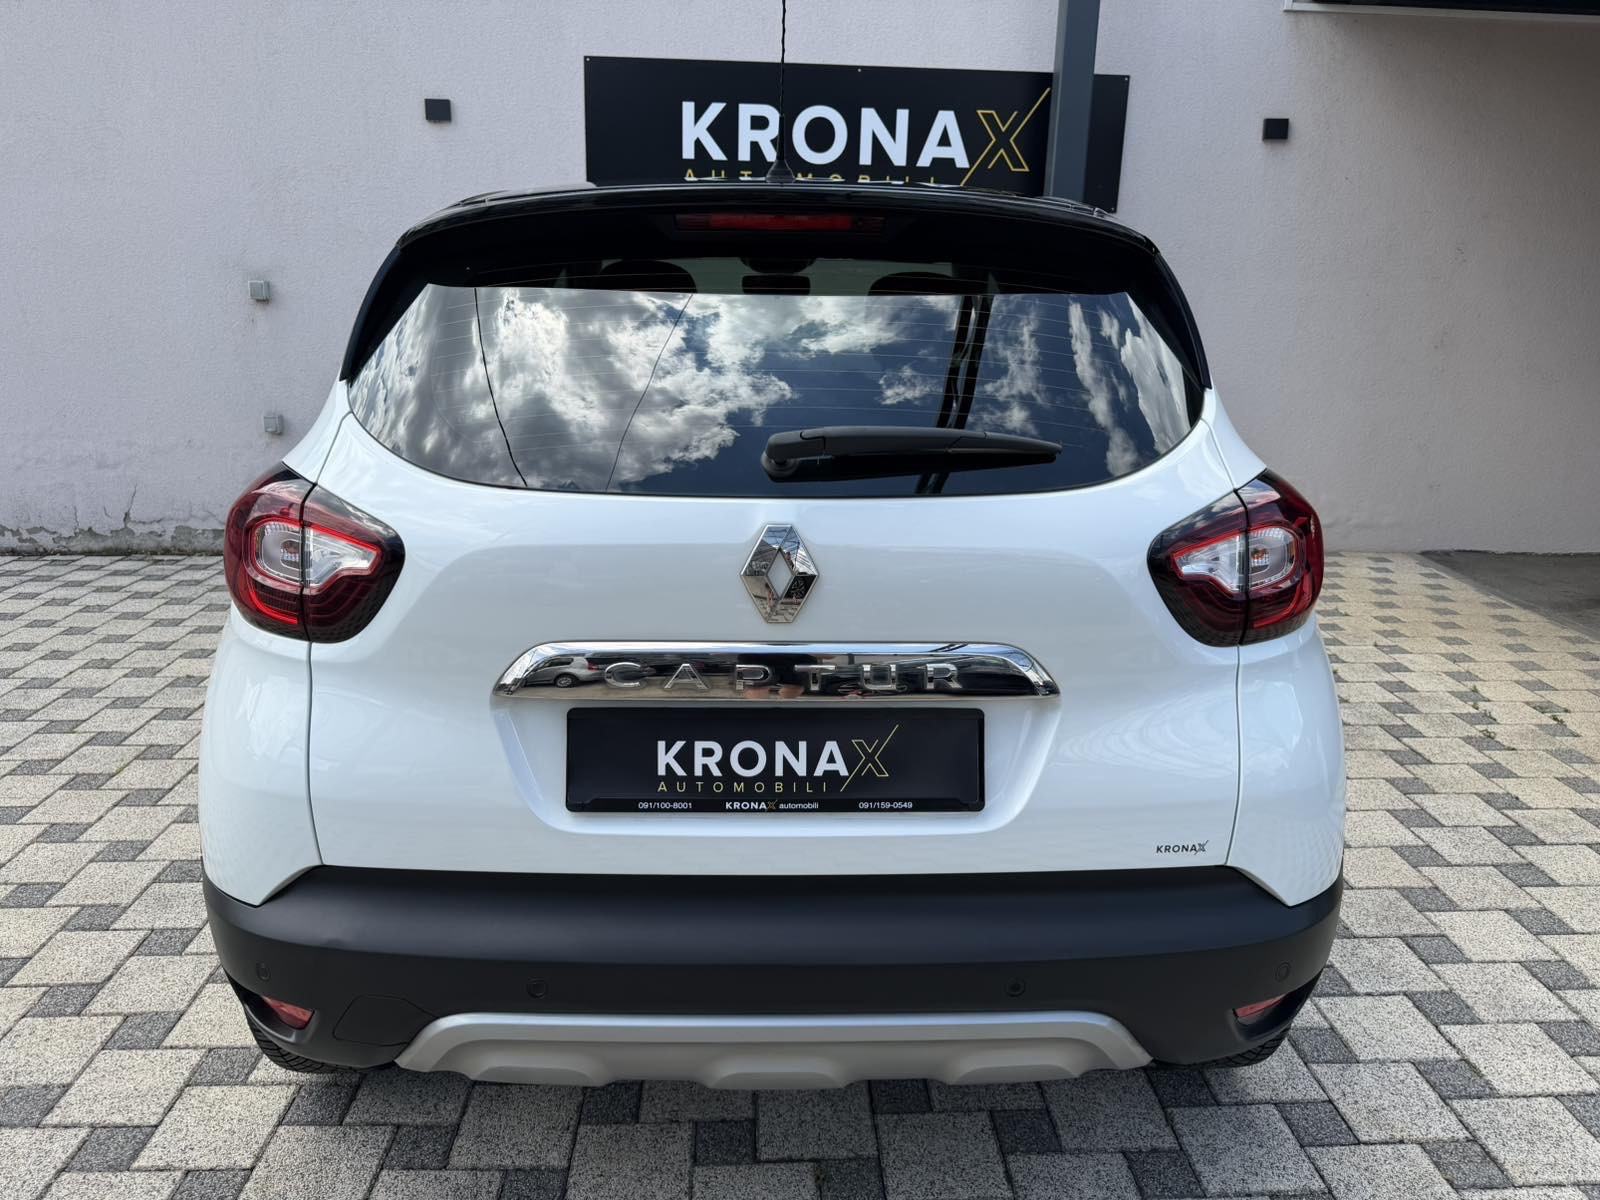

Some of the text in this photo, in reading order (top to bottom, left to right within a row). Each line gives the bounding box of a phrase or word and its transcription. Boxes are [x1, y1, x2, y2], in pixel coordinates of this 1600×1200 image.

[681, 87, 1051, 187] KRONAX
[604, 661, 963, 692] CAPTUR
[657, 724, 899, 792] KRONAX
[657, 781, 827, 793] AUTOMOBILI
[638, 800, 913, 811] 091/100-8001 KRONAX automobili 091/159-0549
[1156, 839, 1209, 855] KRONAX
